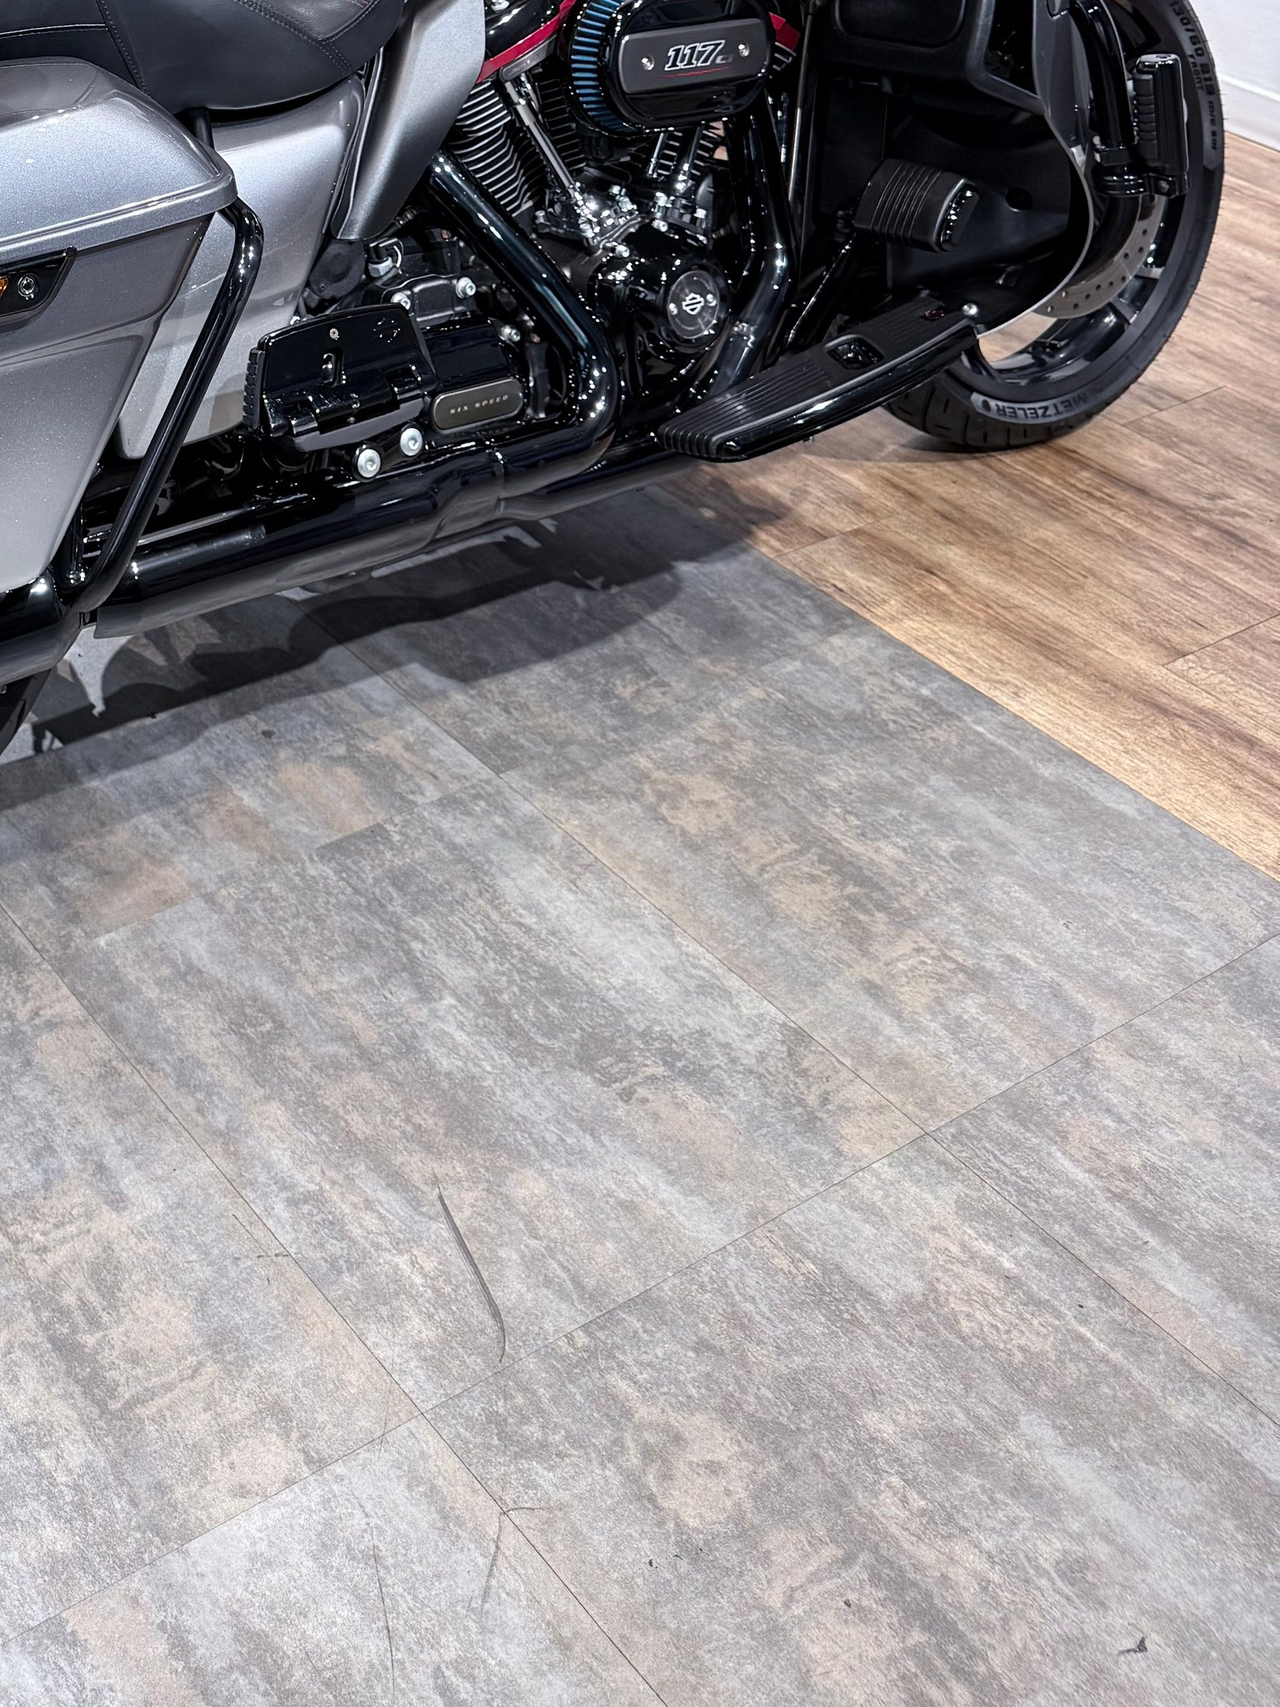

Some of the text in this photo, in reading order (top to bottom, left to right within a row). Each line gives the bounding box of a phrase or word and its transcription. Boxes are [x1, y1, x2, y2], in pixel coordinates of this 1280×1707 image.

[664, 39, 726, 71] 117
[449, 394, 509, 414] SIX SPEED
[995, 394, 1089, 419] METZELER
